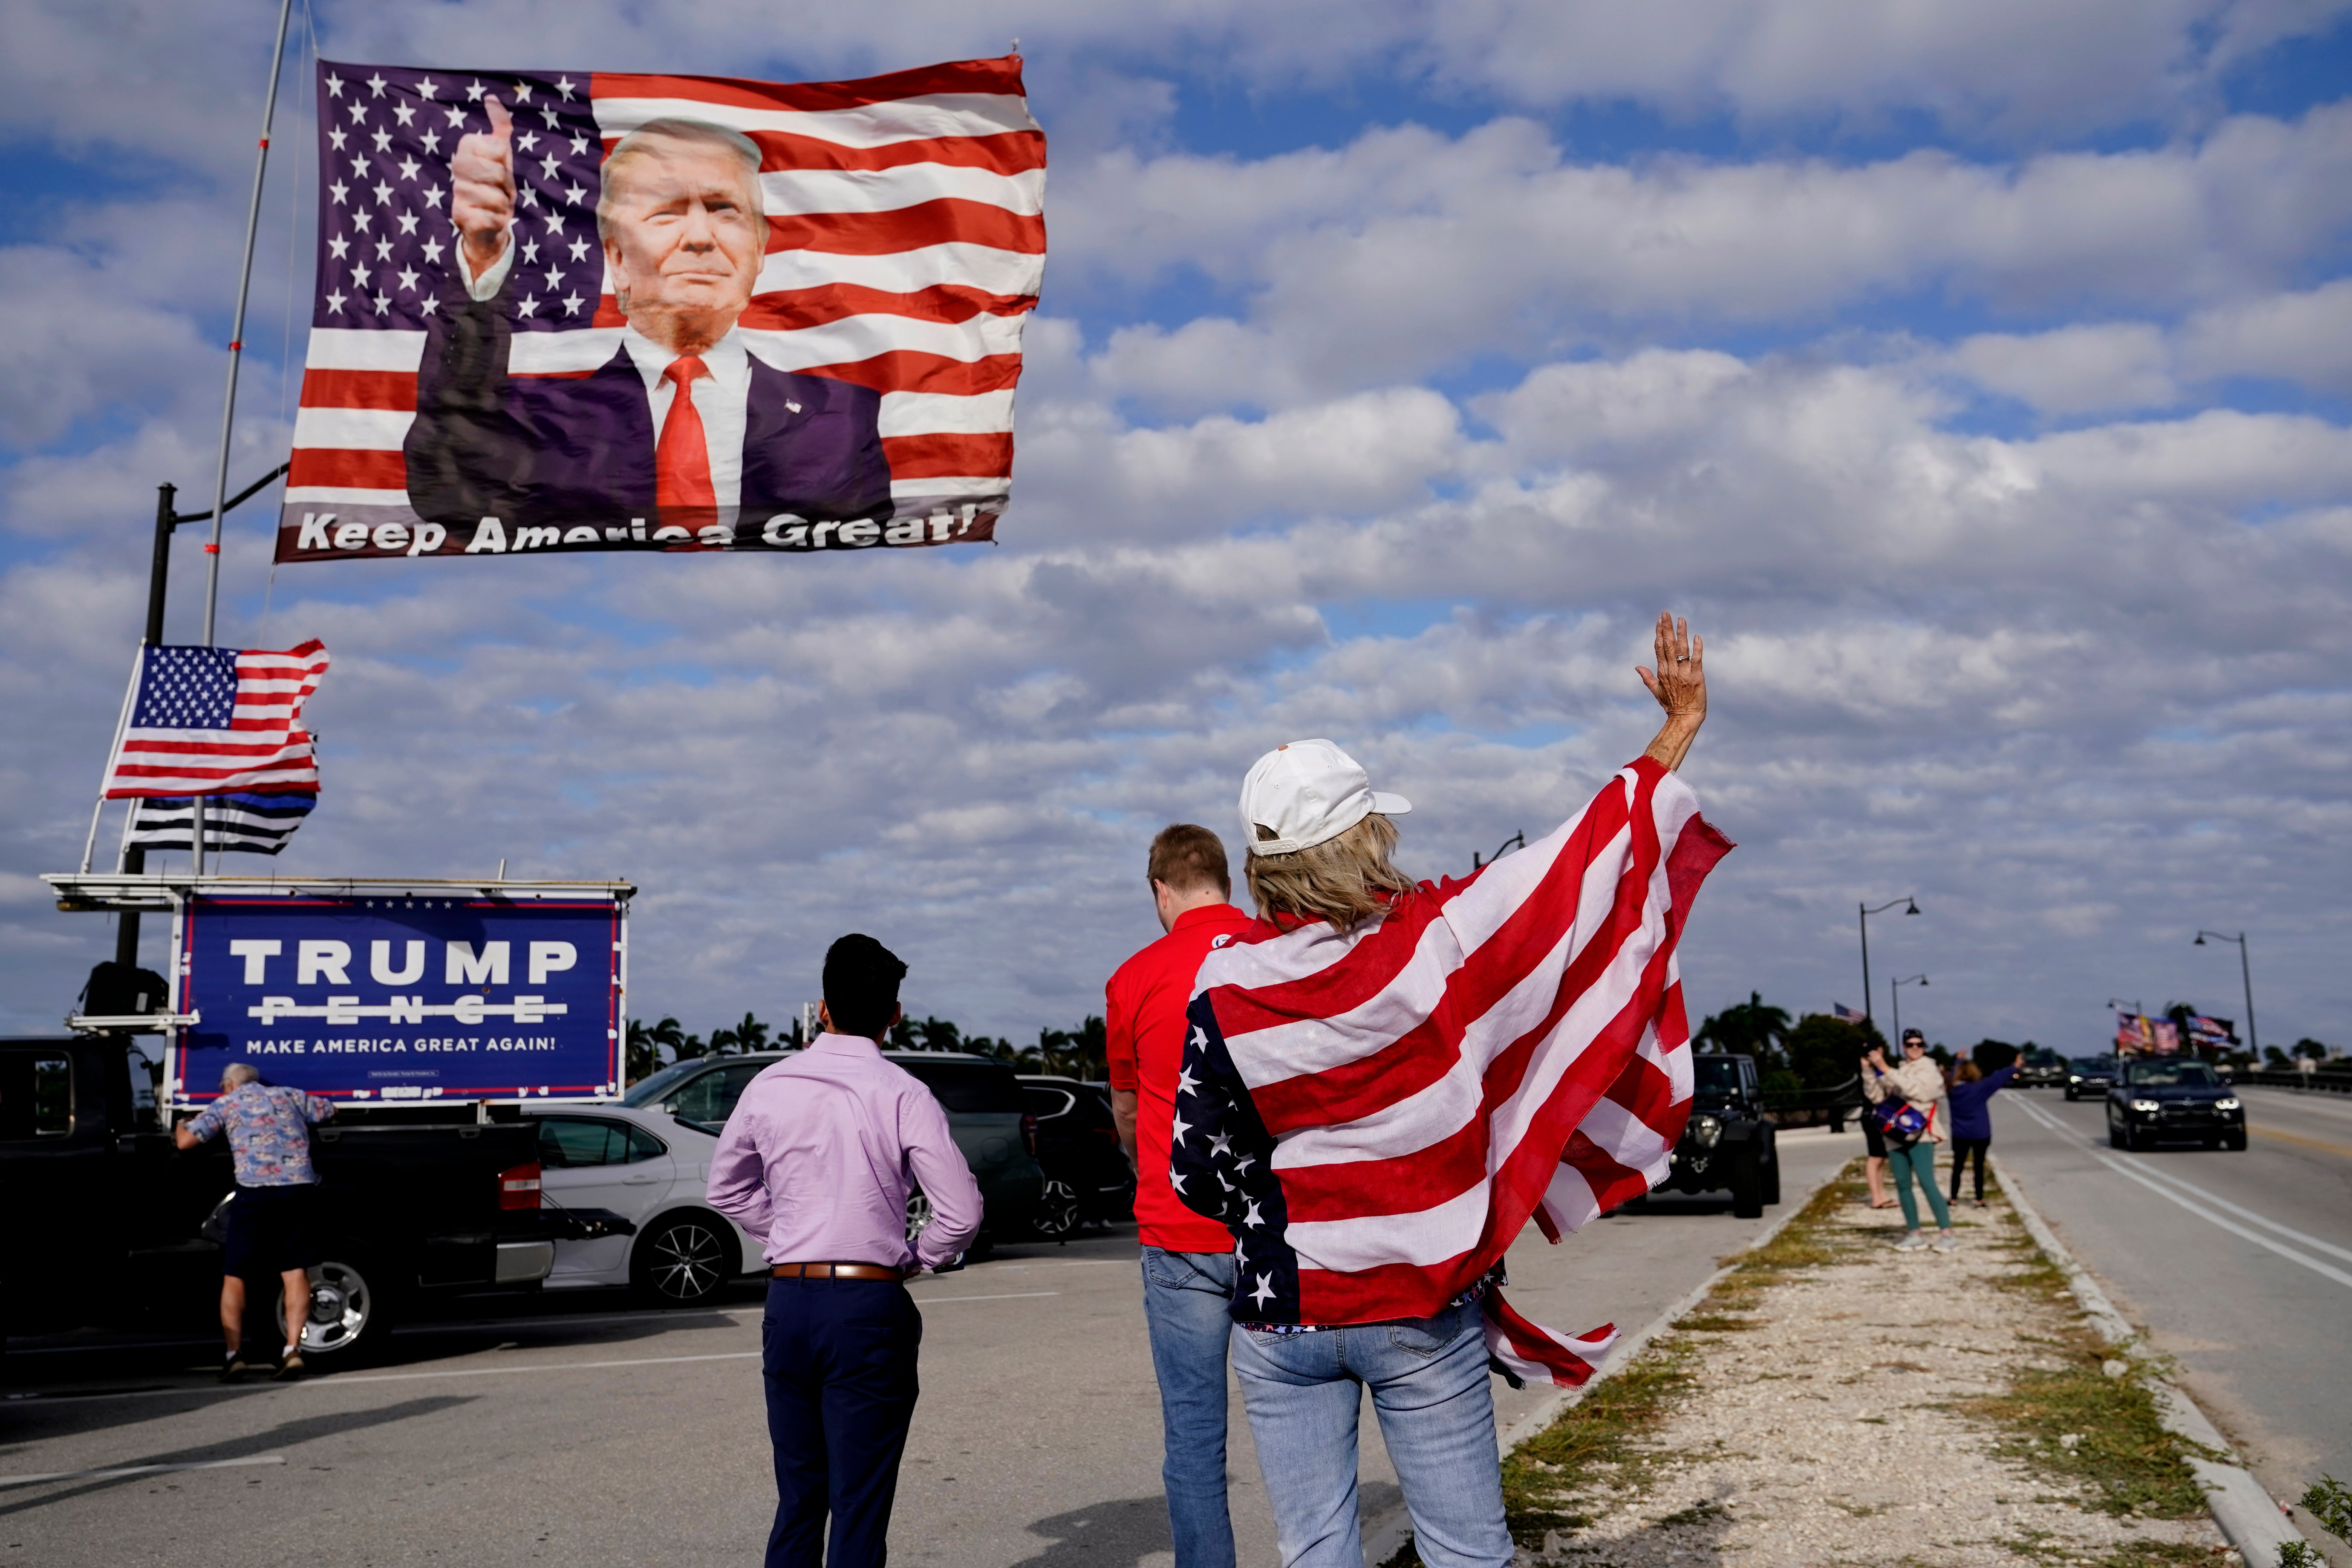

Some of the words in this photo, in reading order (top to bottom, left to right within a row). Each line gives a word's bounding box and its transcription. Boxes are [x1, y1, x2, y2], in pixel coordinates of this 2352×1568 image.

[297, 512, 447, 557] Keep
[762, 503, 976, 547] Great!
[230, 940, 577, 985] TRUMP
[261, 995, 544, 1025] PENCE
[247, 1040, 305, 1054] MAKE
[312, 1039, 407, 1053] AMERICA
[414, 1038, 479, 1052] GREAT
[486, 1037, 556, 1051] AGAIN!
